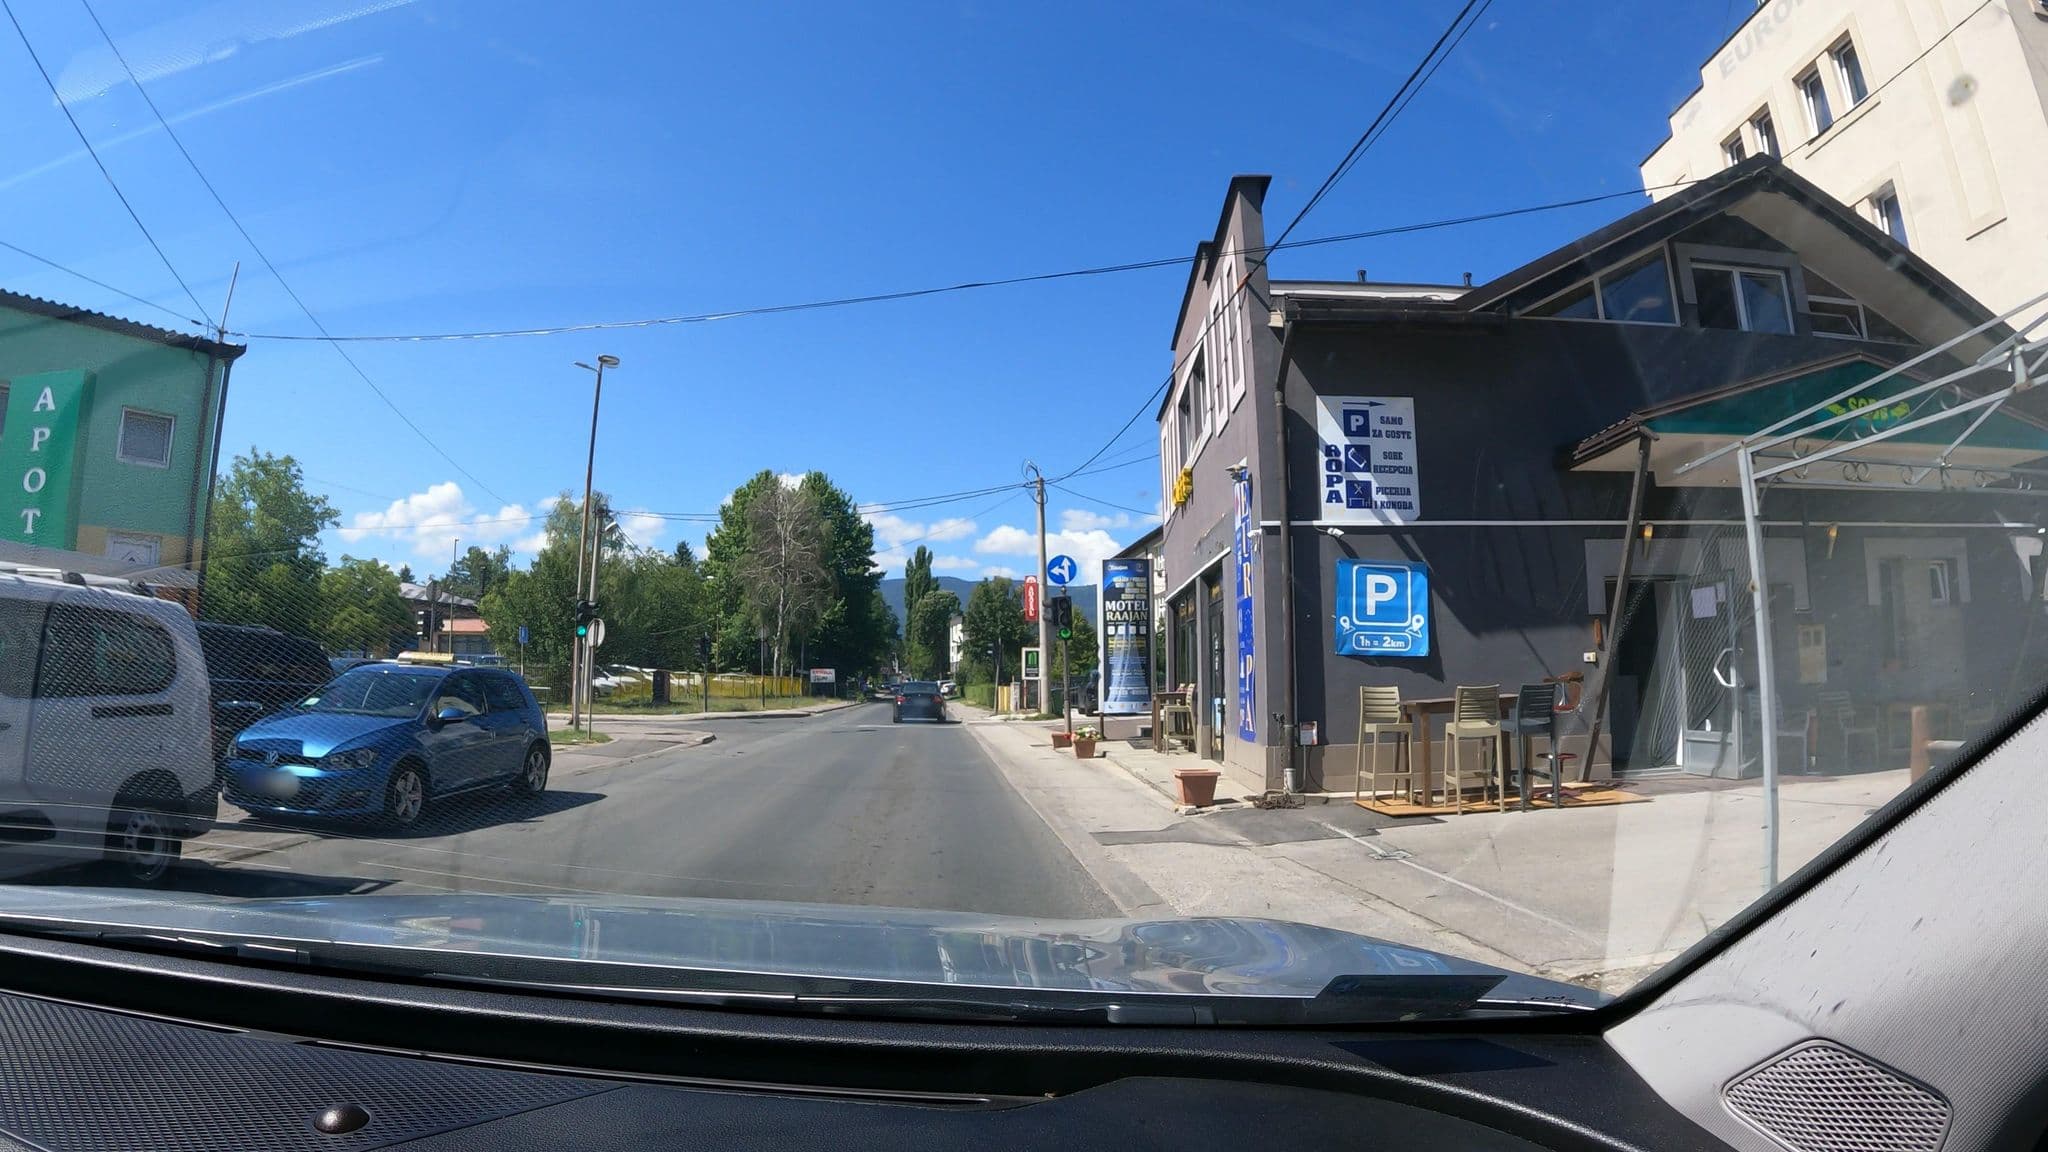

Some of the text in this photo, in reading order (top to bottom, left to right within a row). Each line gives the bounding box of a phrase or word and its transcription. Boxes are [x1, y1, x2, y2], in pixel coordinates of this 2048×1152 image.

[1716, 0, 1804, 78] EURO
[1350, 414, 1364, 432] P
[1380, 416, 1404, 426] SAMO
[1372, 429, 1412, 440] ZA GOSTE
[1373, 465, 1413, 475] RECEPCIJA
[1380, 501, 1414, 510] KONOBA
[1366, 573, 1397, 617] P
[1105, 600, 1149, 611] MOTEL
[1106, 611, 1148, 622] RAAJAN
[1359, 635, 1371, 648] 1h
[1383, 636, 1405, 649] 2km
